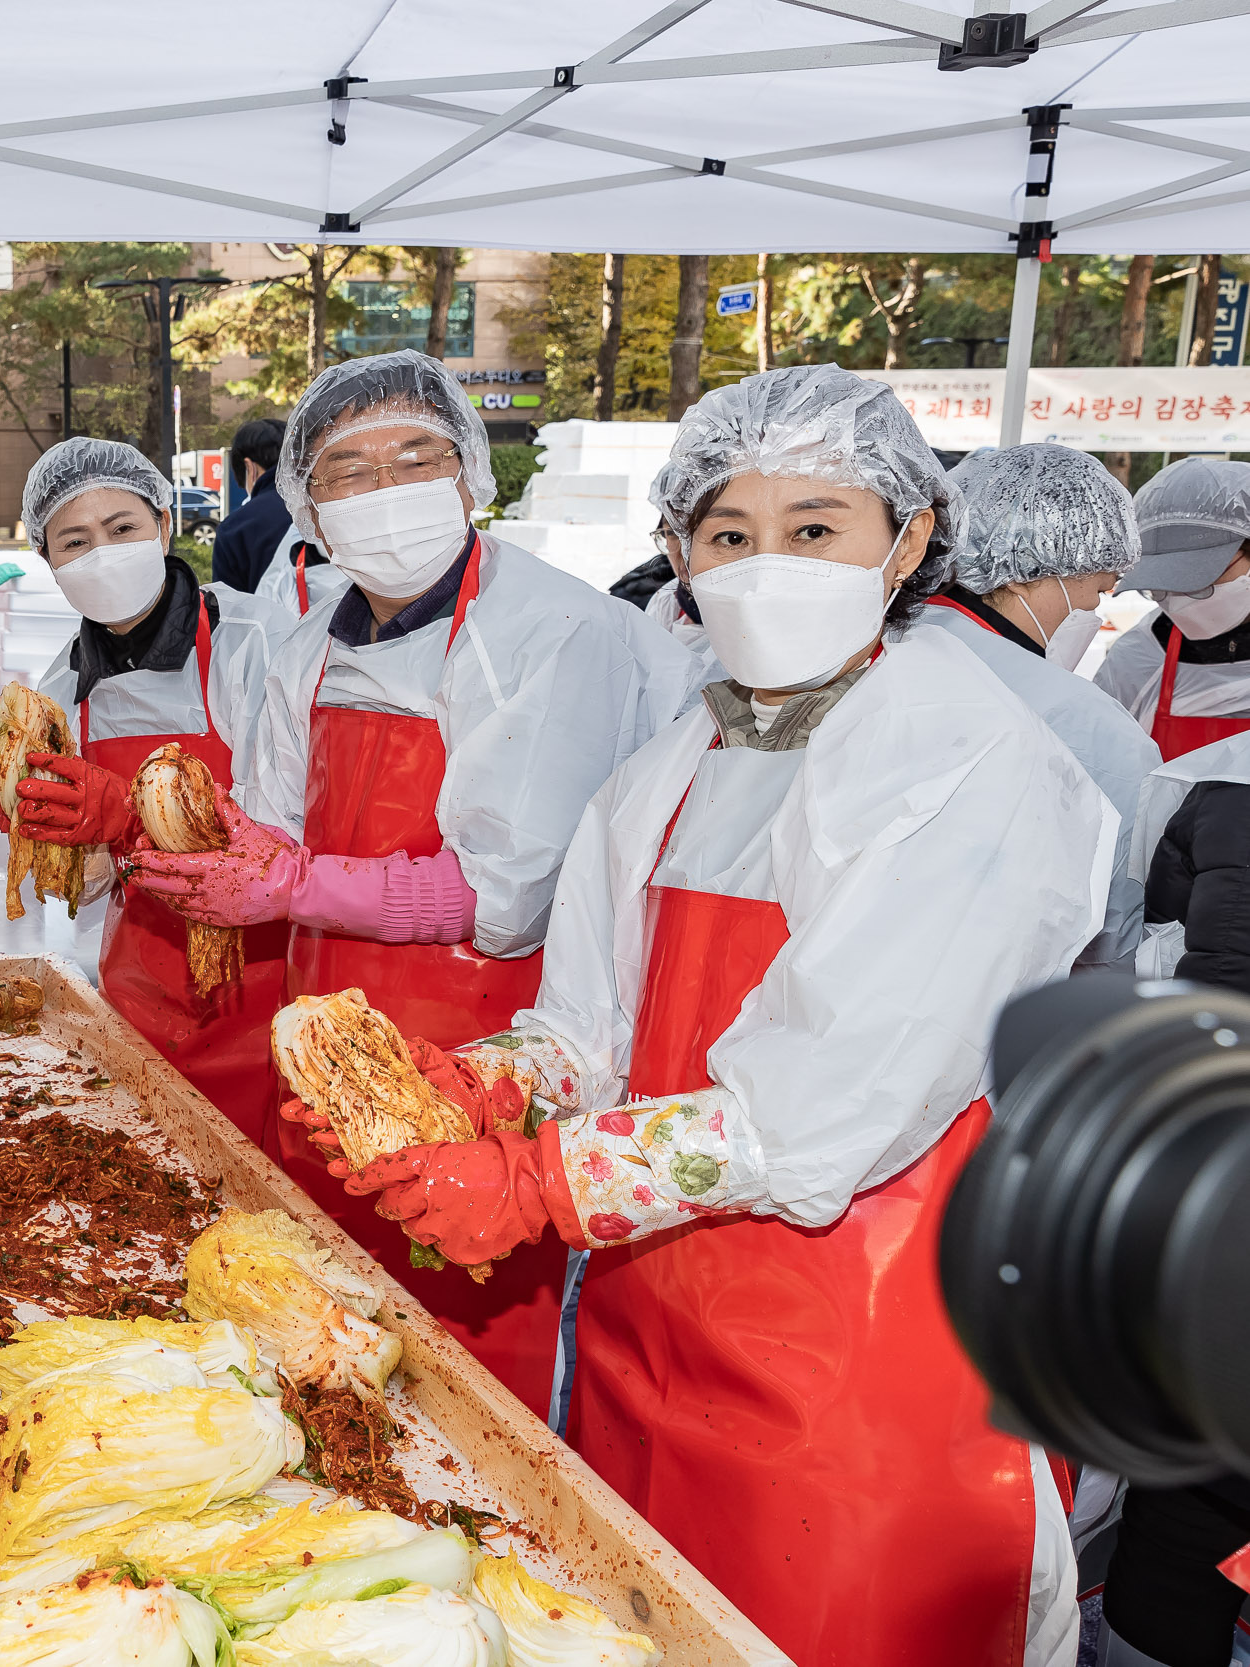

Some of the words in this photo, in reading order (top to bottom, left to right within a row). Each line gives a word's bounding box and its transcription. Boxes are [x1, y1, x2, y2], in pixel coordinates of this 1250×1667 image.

[1211, 278, 1243, 367] 광진구
[483, 392, 511, 410] CU
[926, 397, 992, 420] 제1회
[1027, 396, 1052, 421] 진
[1062, 396, 1143, 421] 사랑의
